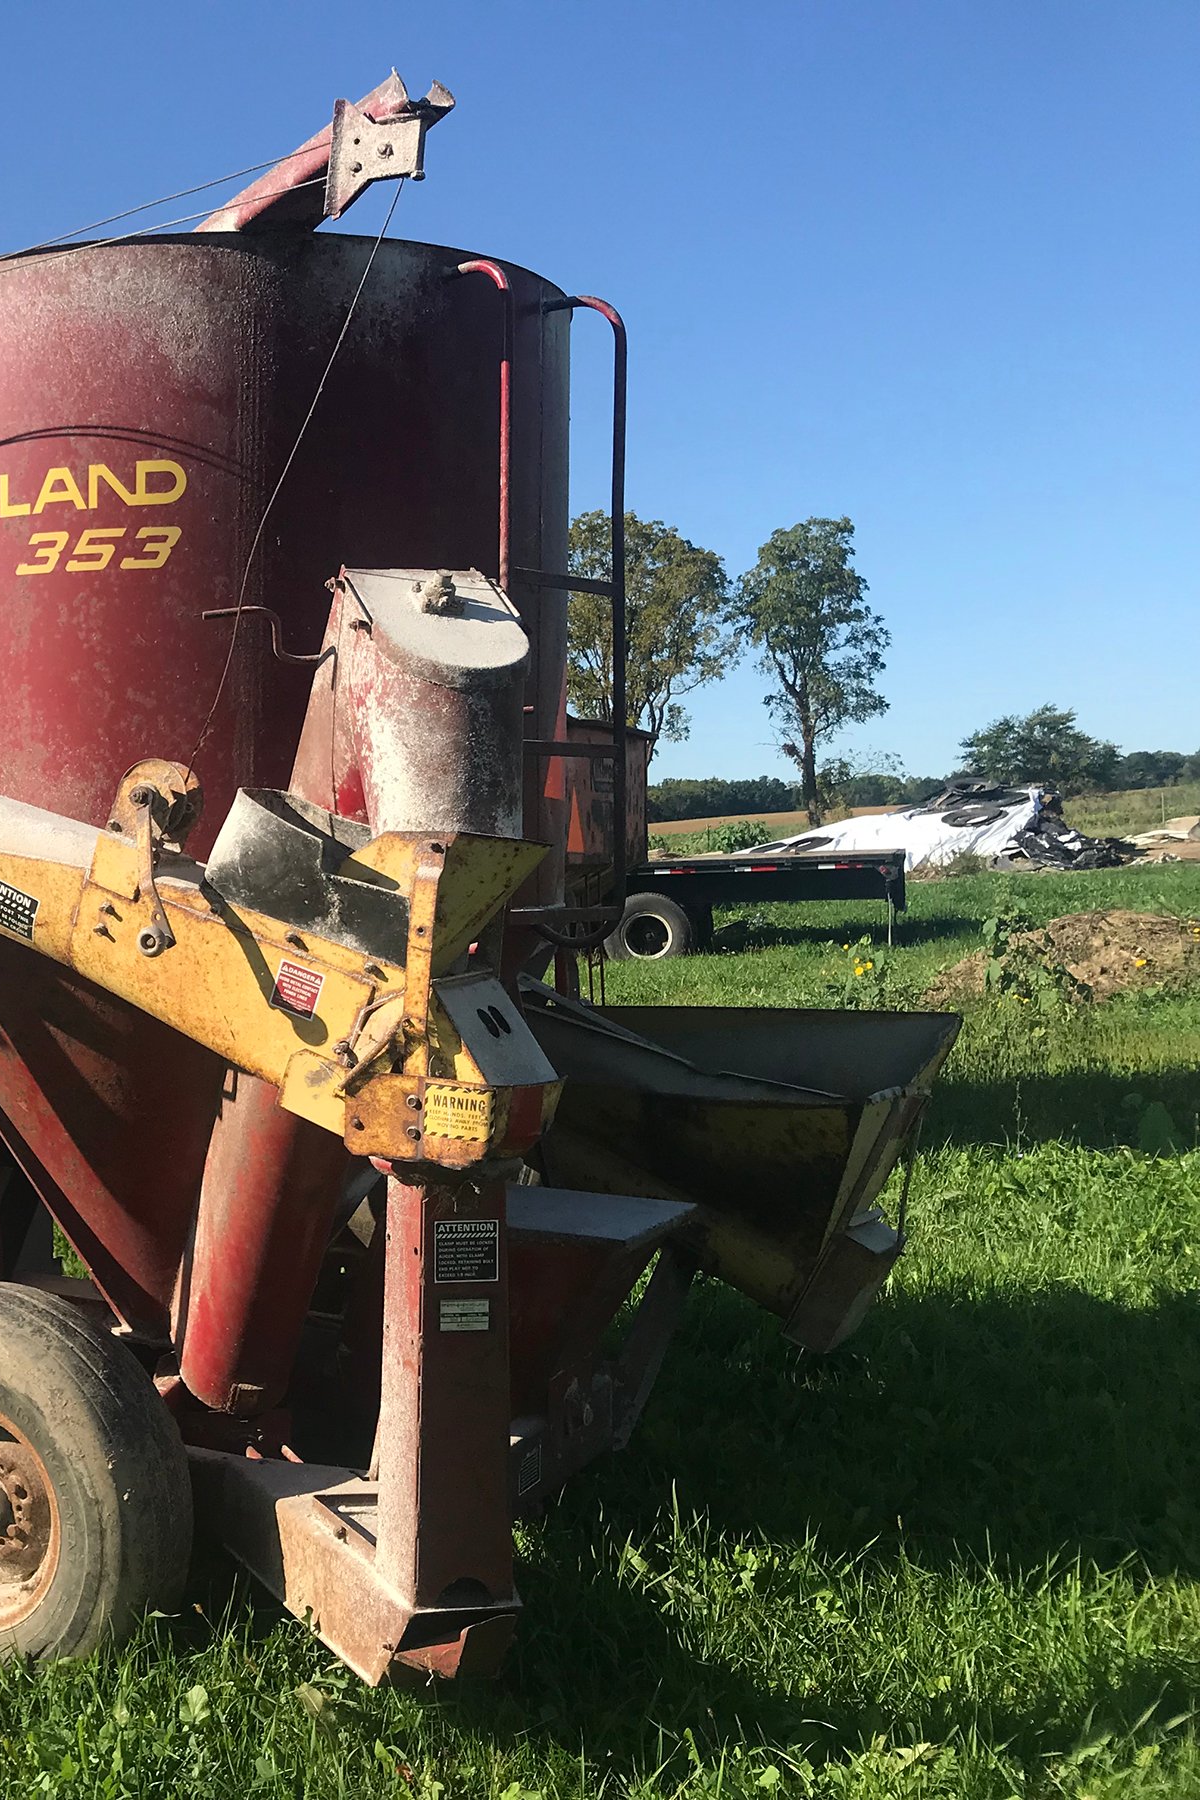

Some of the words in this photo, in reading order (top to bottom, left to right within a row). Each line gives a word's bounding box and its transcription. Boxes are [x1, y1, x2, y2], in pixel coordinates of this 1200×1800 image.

[15, 526, 183, 576] 353
[18, 915, 28, 923] THIS
[288, 968, 314, 982] DANGER
[434, 1094, 486, 1111] WARNING
[438, 1223, 494, 1233] ATTENTION
